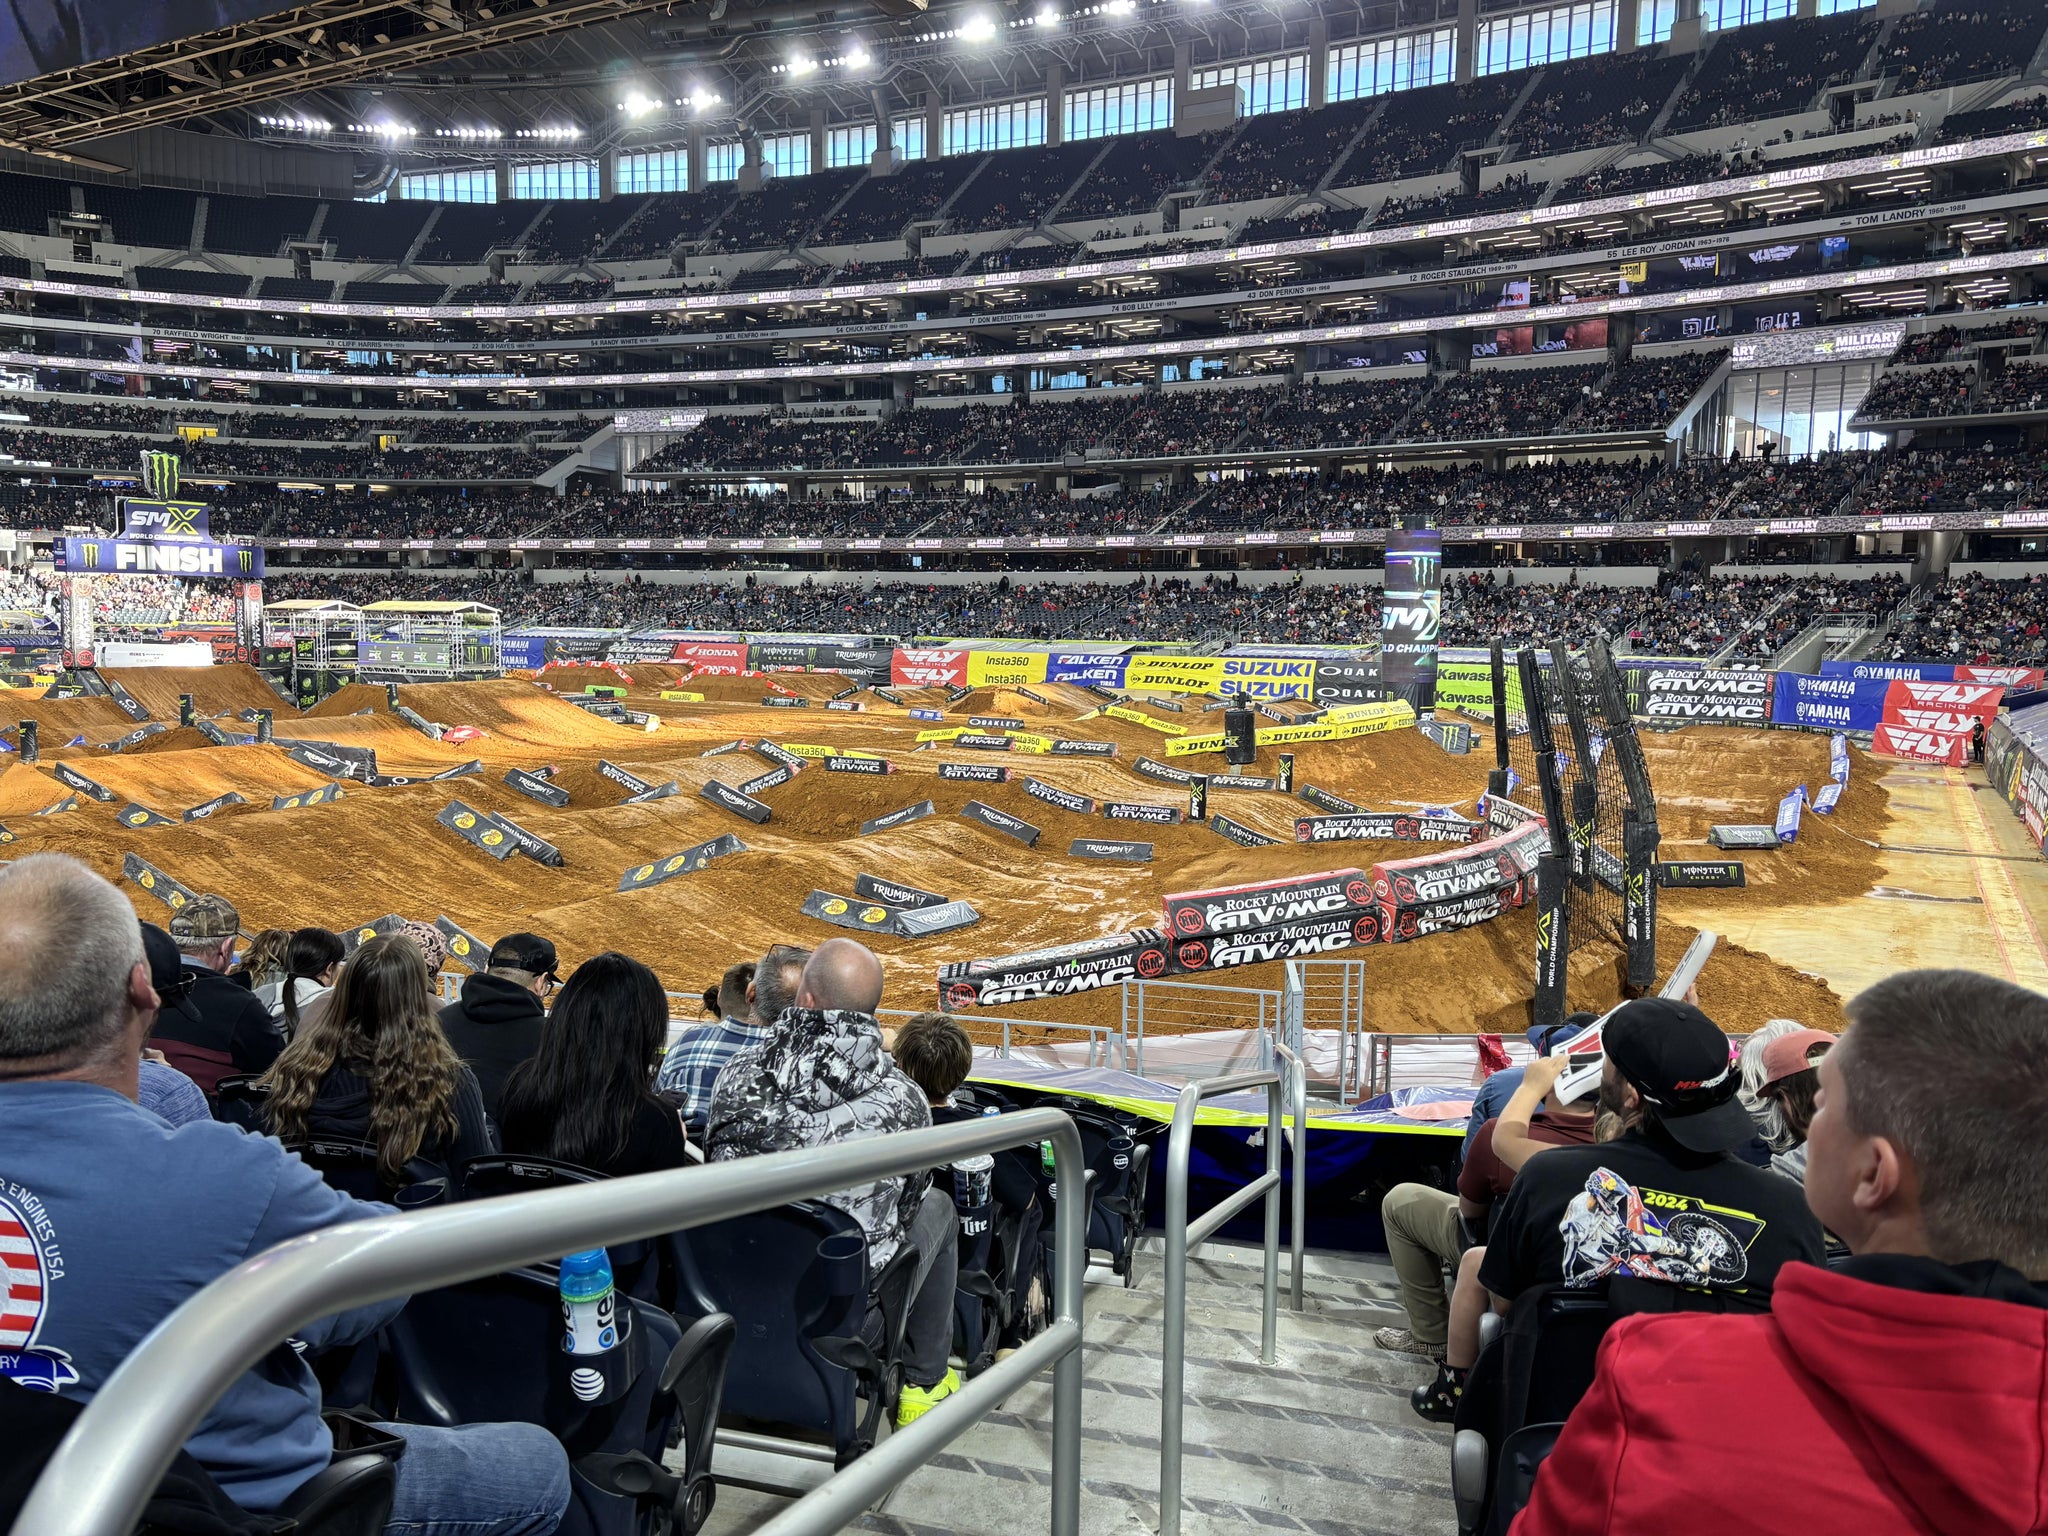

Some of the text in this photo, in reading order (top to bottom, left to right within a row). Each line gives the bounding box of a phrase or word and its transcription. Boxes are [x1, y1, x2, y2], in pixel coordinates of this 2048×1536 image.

[1903, 143, 1965, 162] MILITARY
[1769, 165, 1826, 181] MILITARY
[1647, 186, 1699, 200] MILITARY
[1533, 204, 1581, 218] MILITARY
[1856, 204, 1966, 226] TOM LANDRY 1960-1988
[1428, 219, 1474, 233] MILITARY
[1330, 232, 1372, 244] MILITARY
[1238, 244, 1277, 256] MILITARY
[1607, 240, 1696, 259] 55 LEE ROY JORDAN
[1150, 253, 1188, 265] MILITARY
[1950, 257, 1991, 269] MILITARY
[1409, 274, 1417, 282] 12
[1421, 271, 1447, 281] ROGER
[1448, 266, 1487, 278] STAUBACH
[1857, 269, 1897, 281] MILITARY
[33, 280, 77, 292] MILITARY
[1769, 279, 1807, 291] MILITARY
[1259, 290, 1273, 298] DON
[1275, 287, 1304, 297] PERKINS
[223, 298, 262, 307] MILITARY
[312, 303, 349, 312] MILITARY
[1137, 302, 1154, 311] LILLY
[1609, 299, 1643, 310] MILITARY
[992, 314, 1022, 323] MEREDITH
[164, 329, 198, 338] RAYFIELD
[200, 332, 229, 340] WRIGHT
[1836, 331, 1902, 346] MILITARY
[1836, 343, 1880, 352] APPRECIATION
[129, 507, 201, 535] SMX
[1668, 523, 1712, 532] MILITARY
[1770, 520, 1819, 529] MILITARY
[1882, 516, 1935, 526] MILITARY
[1573, 526, 1614, 534] MILITARY
[116, 544, 223, 573] FINISH
[503, 641, 529, 649] YAMAHA
[698, 648, 738, 656] HONDA
[763, 648, 804, 656] MONSTER
[836, 651, 868, 660] TRIUMPH
[902, 651, 962, 662] FLY
[502, 656, 528, 665] YAMAHA
[986, 656, 1030, 667] Insta360
[1057, 655, 1124, 666] FALKEN
[1146, 659, 1214, 670] DUNLOP
[900, 668, 959, 680] FLY
[1054, 670, 1118, 681] FALKEN
[1223, 662, 1312, 677] SUZUKI
[1665, 669, 1767, 681] ROCKY MOUNTAIN
[1869, 667, 1921, 681] YAMAHA
[985, 674, 1027, 685] Insta360
[1143, 675, 1210, 688] DUNLOP
[772, 684, 788, 694] FLY
[1220, 680, 1309, 699] SUZUKI
[1807, 678, 1856, 695] YAMAHA
[1904, 682, 1993, 703] FLY
[669, 693, 692, 701] Insta360
[1664, 693, 1764, 706] ROCKY MOUNTAIN
[1110, 708, 1140, 722] Insta360
[1804, 705, 1850, 721] YAMAHA
[981, 720, 1017, 728] OAKLEY
[1897, 708, 1983, 732] FLY
[921, 729, 954, 739] Insta360
[1351, 721, 1387, 736] DUNLOP
[1274, 729, 1332, 742] DUNLOP
[1884, 727, 1954, 757] FLY
[788, 745, 825, 756] Insta360
[970, 766, 999, 774] MOUNTAIN
[518, 776, 547, 794] TRIUMPH
[717, 788, 748, 807] TRIUMPH
[1038, 783, 1085, 803] ROCKY MOUNTAIN
[1318, 793, 1354, 811] MONSTER
[191, 801, 216, 818] TRIUMPH
[1121, 804, 1171, 814] ROCKY MOUNTAIN
[875, 808, 908, 826] TRIUMPH
[980, 807, 1016, 828] TRIUMPH
[1325, 818, 1393, 828] ROCKY MOUNTAIN
[1428, 820, 1471, 833] ROCKY MOUNTAIN
[1230, 826, 1270, 845] MONSTER
[1086, 844, 1123, 854] TRIUMPH
[1426, 858, 1497, 882] ROCKY MOUNTAIN
[1683, 866, 1726, 876] MONSTER
[872, 883, 915, 903] TRIUMPH
[1227, 884, 1341, 911] ROCKY MOUNTAIN
[1435, 895, 1498, 917] ROCKY MOUNTAIN
[1233, 920, 1351, 946] ROCKY MOUNTAIN
[1548, 907, 1560, 987] WORLD CHAMPIONSHIP
[1002, 954, 1133, 988] ROCKY MOUNTAIN
[1643, 1191, 1689, 1211] 2024
[9, 1183, 65, 1281] ENGINES USA
[962, 1217, 988, 1237] Lite
